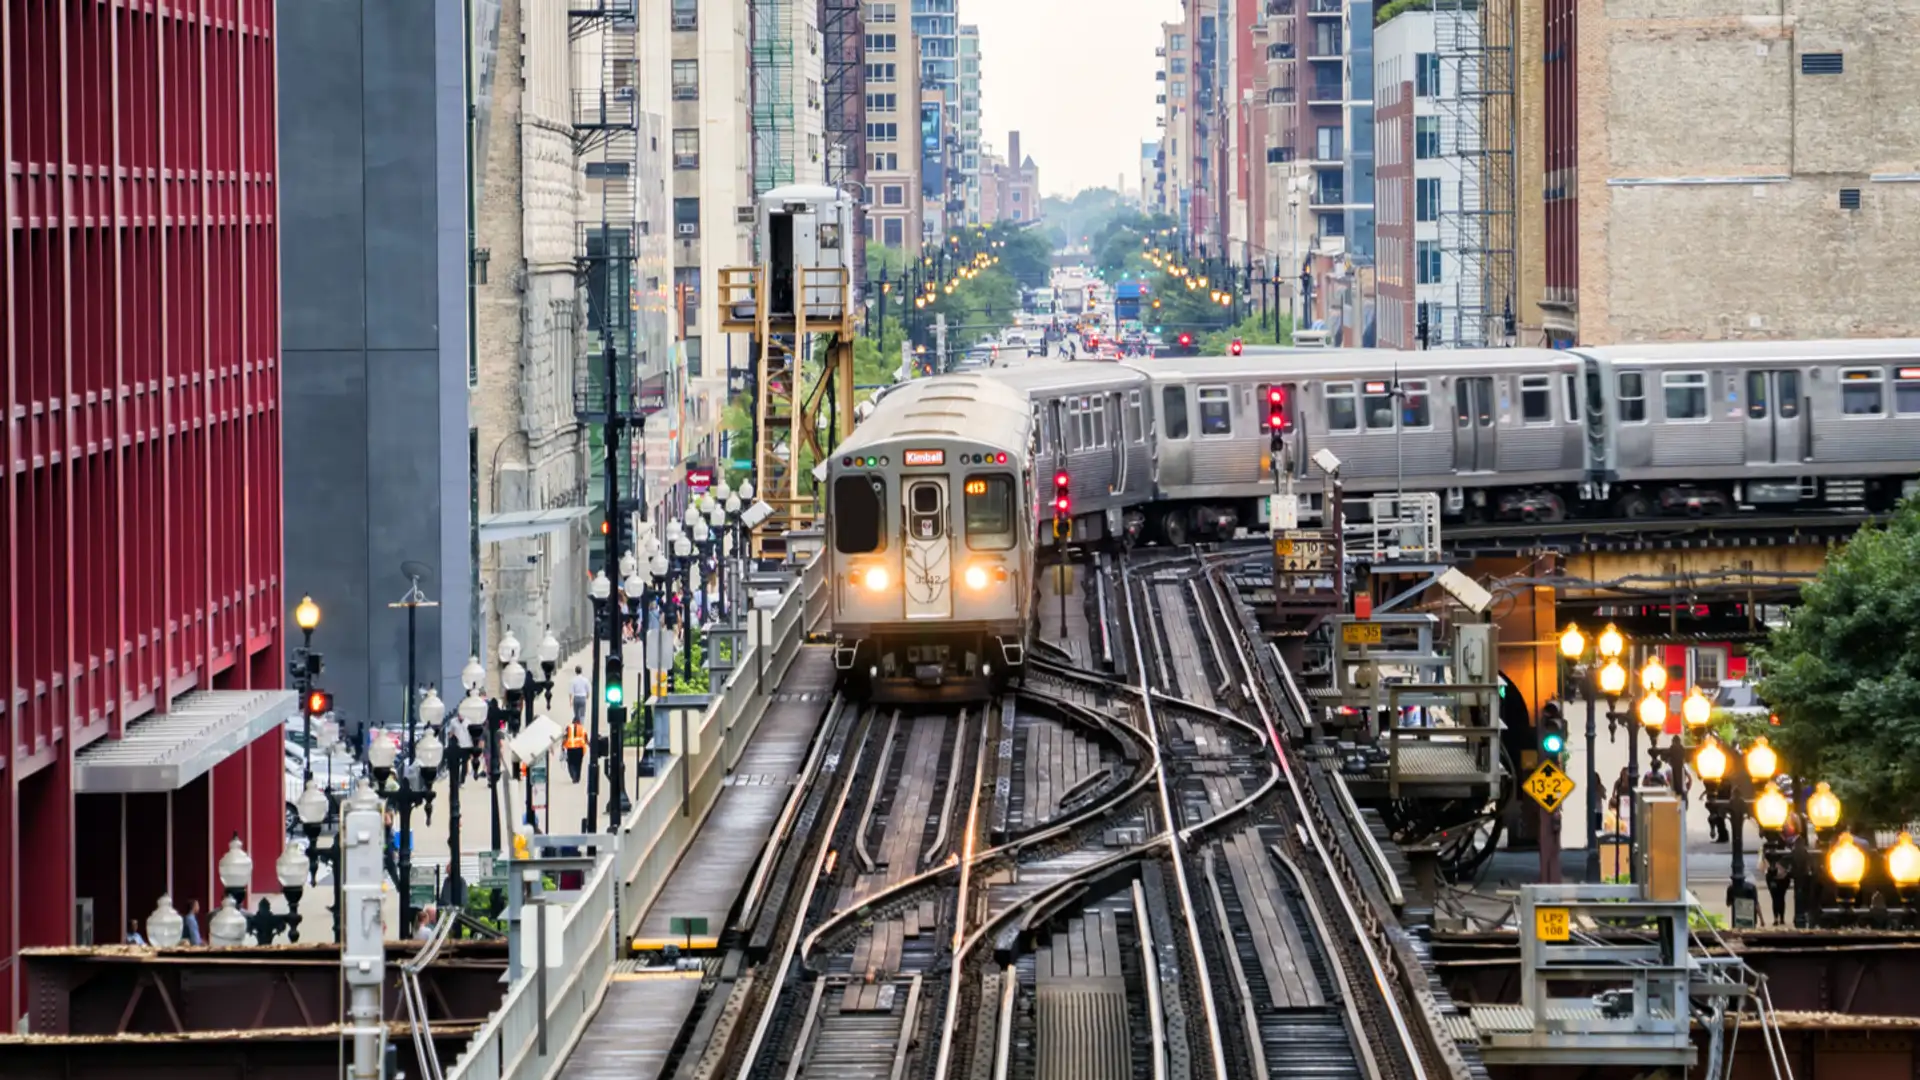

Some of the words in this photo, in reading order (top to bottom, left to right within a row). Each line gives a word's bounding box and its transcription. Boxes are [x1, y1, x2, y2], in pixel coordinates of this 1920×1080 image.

[906, 452, 943, 463] Kimball
[966, 481, 986, 493] 413
[1364, 626, 1379, 638] 35
